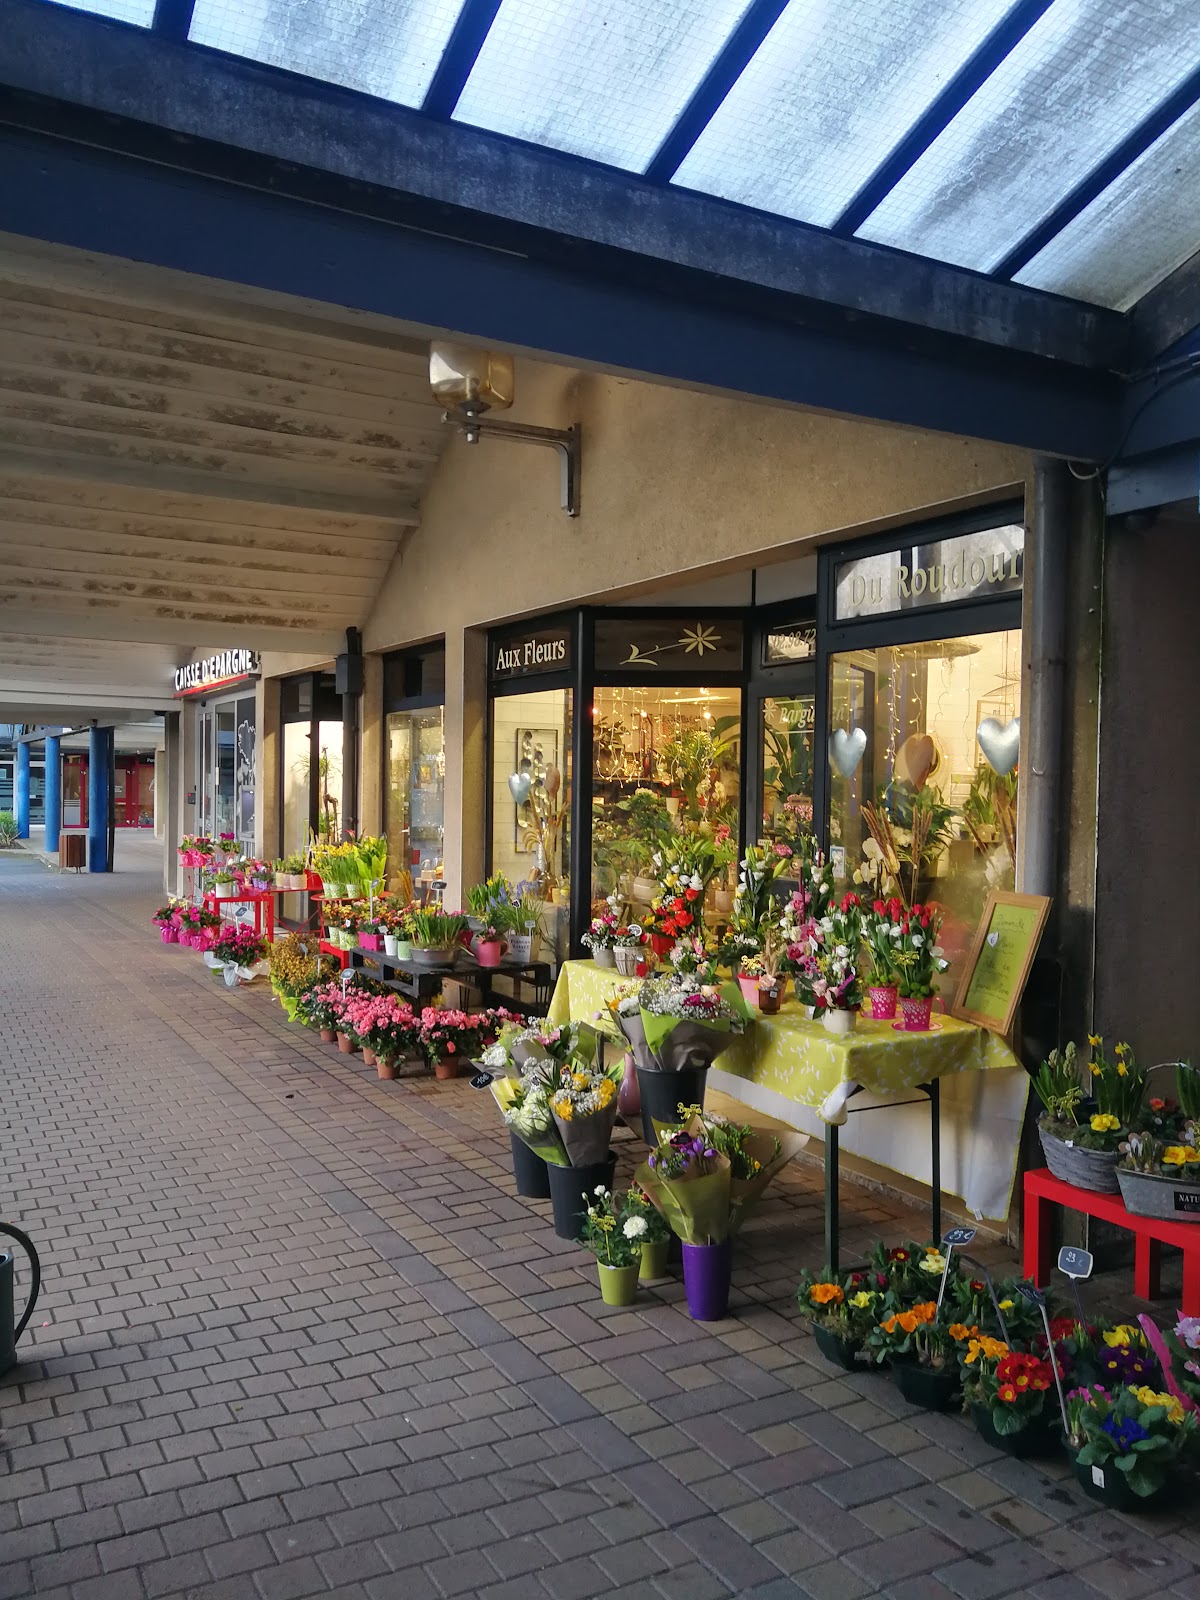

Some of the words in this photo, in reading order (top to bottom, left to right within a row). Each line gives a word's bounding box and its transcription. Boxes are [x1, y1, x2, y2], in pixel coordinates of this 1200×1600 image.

[850, 574, 883, 607] Du
[892, 547, 1024, 599] Roudour
[495, 647, 521, 671] Aux
[523, 639, 566, 666] Fleurs
[174, 661, 200, 691] CAISSE
[1179, 1194, 1200, 1203] NATU
